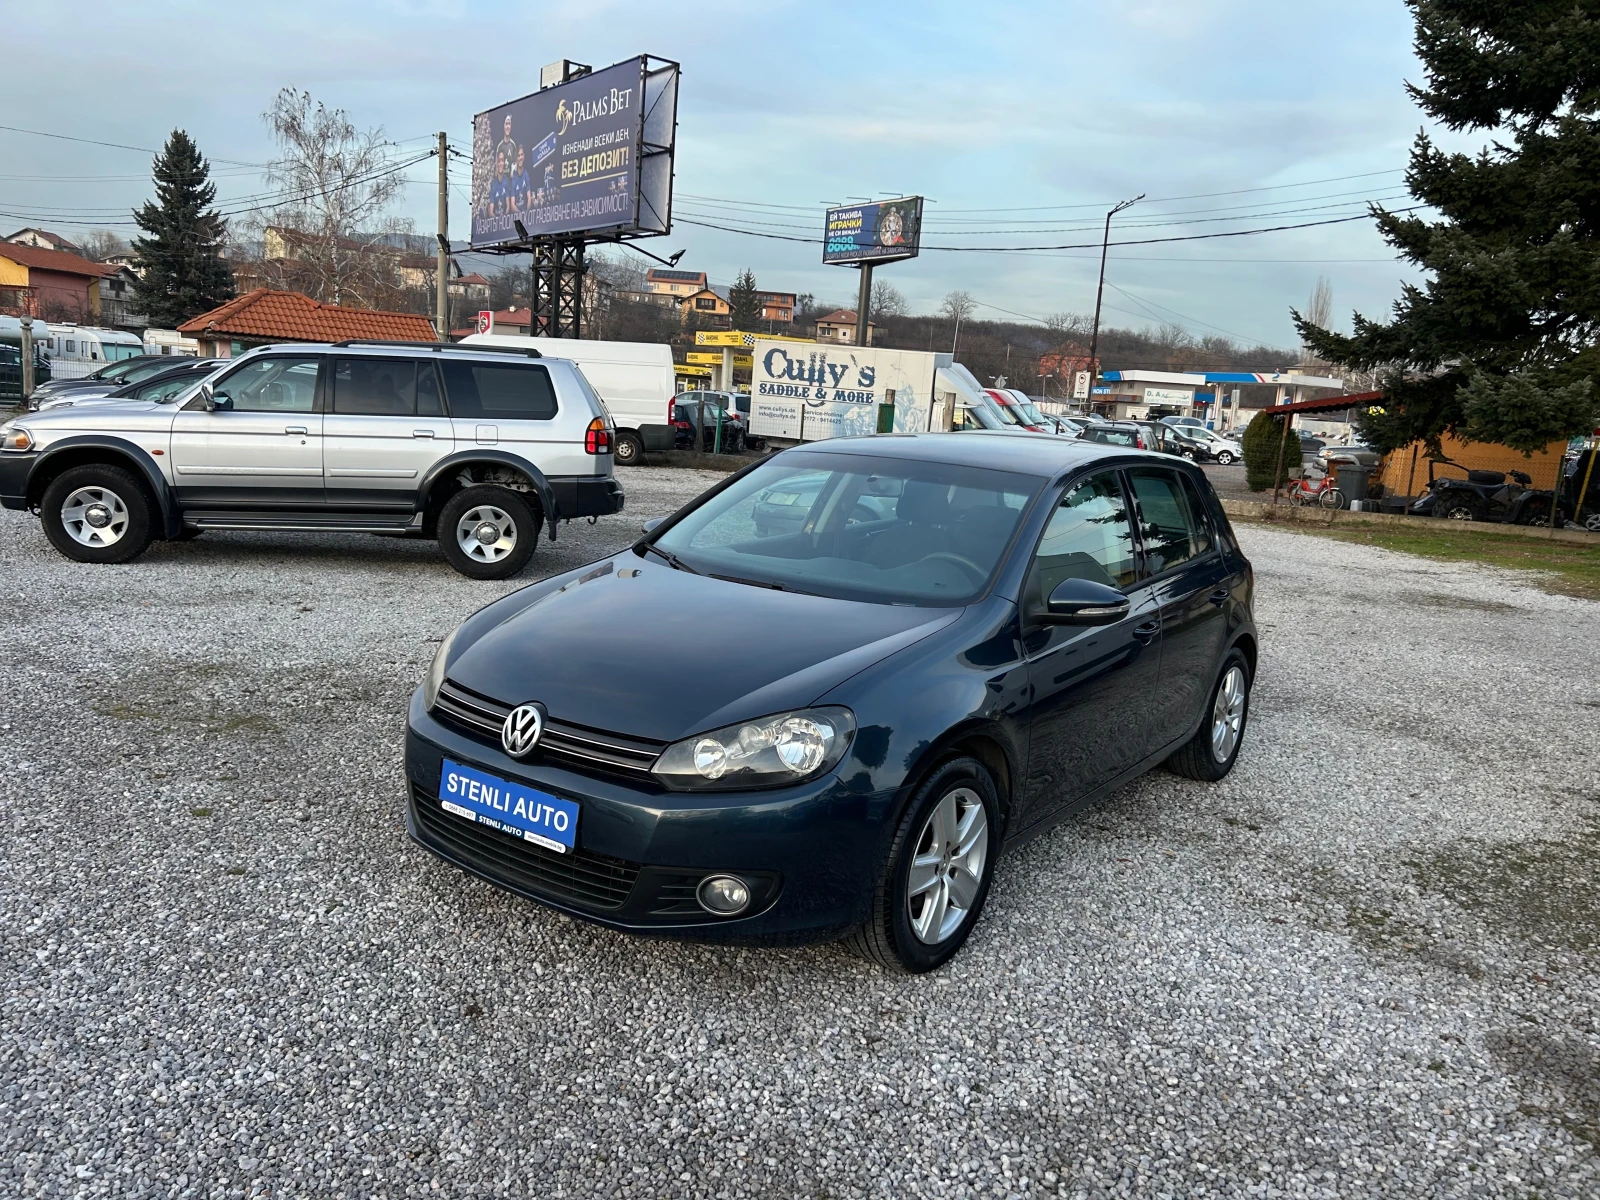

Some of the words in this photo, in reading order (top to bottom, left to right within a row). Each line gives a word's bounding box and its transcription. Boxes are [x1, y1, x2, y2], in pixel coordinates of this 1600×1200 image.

[572, 96, 608, 126] PALMS
[610, 88, 632, 115] BET
[562, 138, 593, 156] ИЗНЕНАДИ
[595, 132, 615, 147] ВСЕКИ
[561, 161, 579, 179] БЕЗ
[580, 147, 629, 178] ДЕПОЗИТ!
[536, 203, 570, 225] РАЗВИВАНЕ
[571, 202, 579, 218] НА
[829, 218, 862, 230] ИГРАЧКИ
[838, 210, 862, 220] ТАКИВА
[759, 383, 810, 398] SADDLE
[815, 387, 827, 399] &
[833, 390, 874, 404] MORE
[759, 411, 797, 420] info@cullys.de
[446, 772, 511, 813] STENLI
[513, 797, 569, 832] AUTO
[478, 815, 501, 829] STENLI
[501, 824, 522, 836] AUTO
